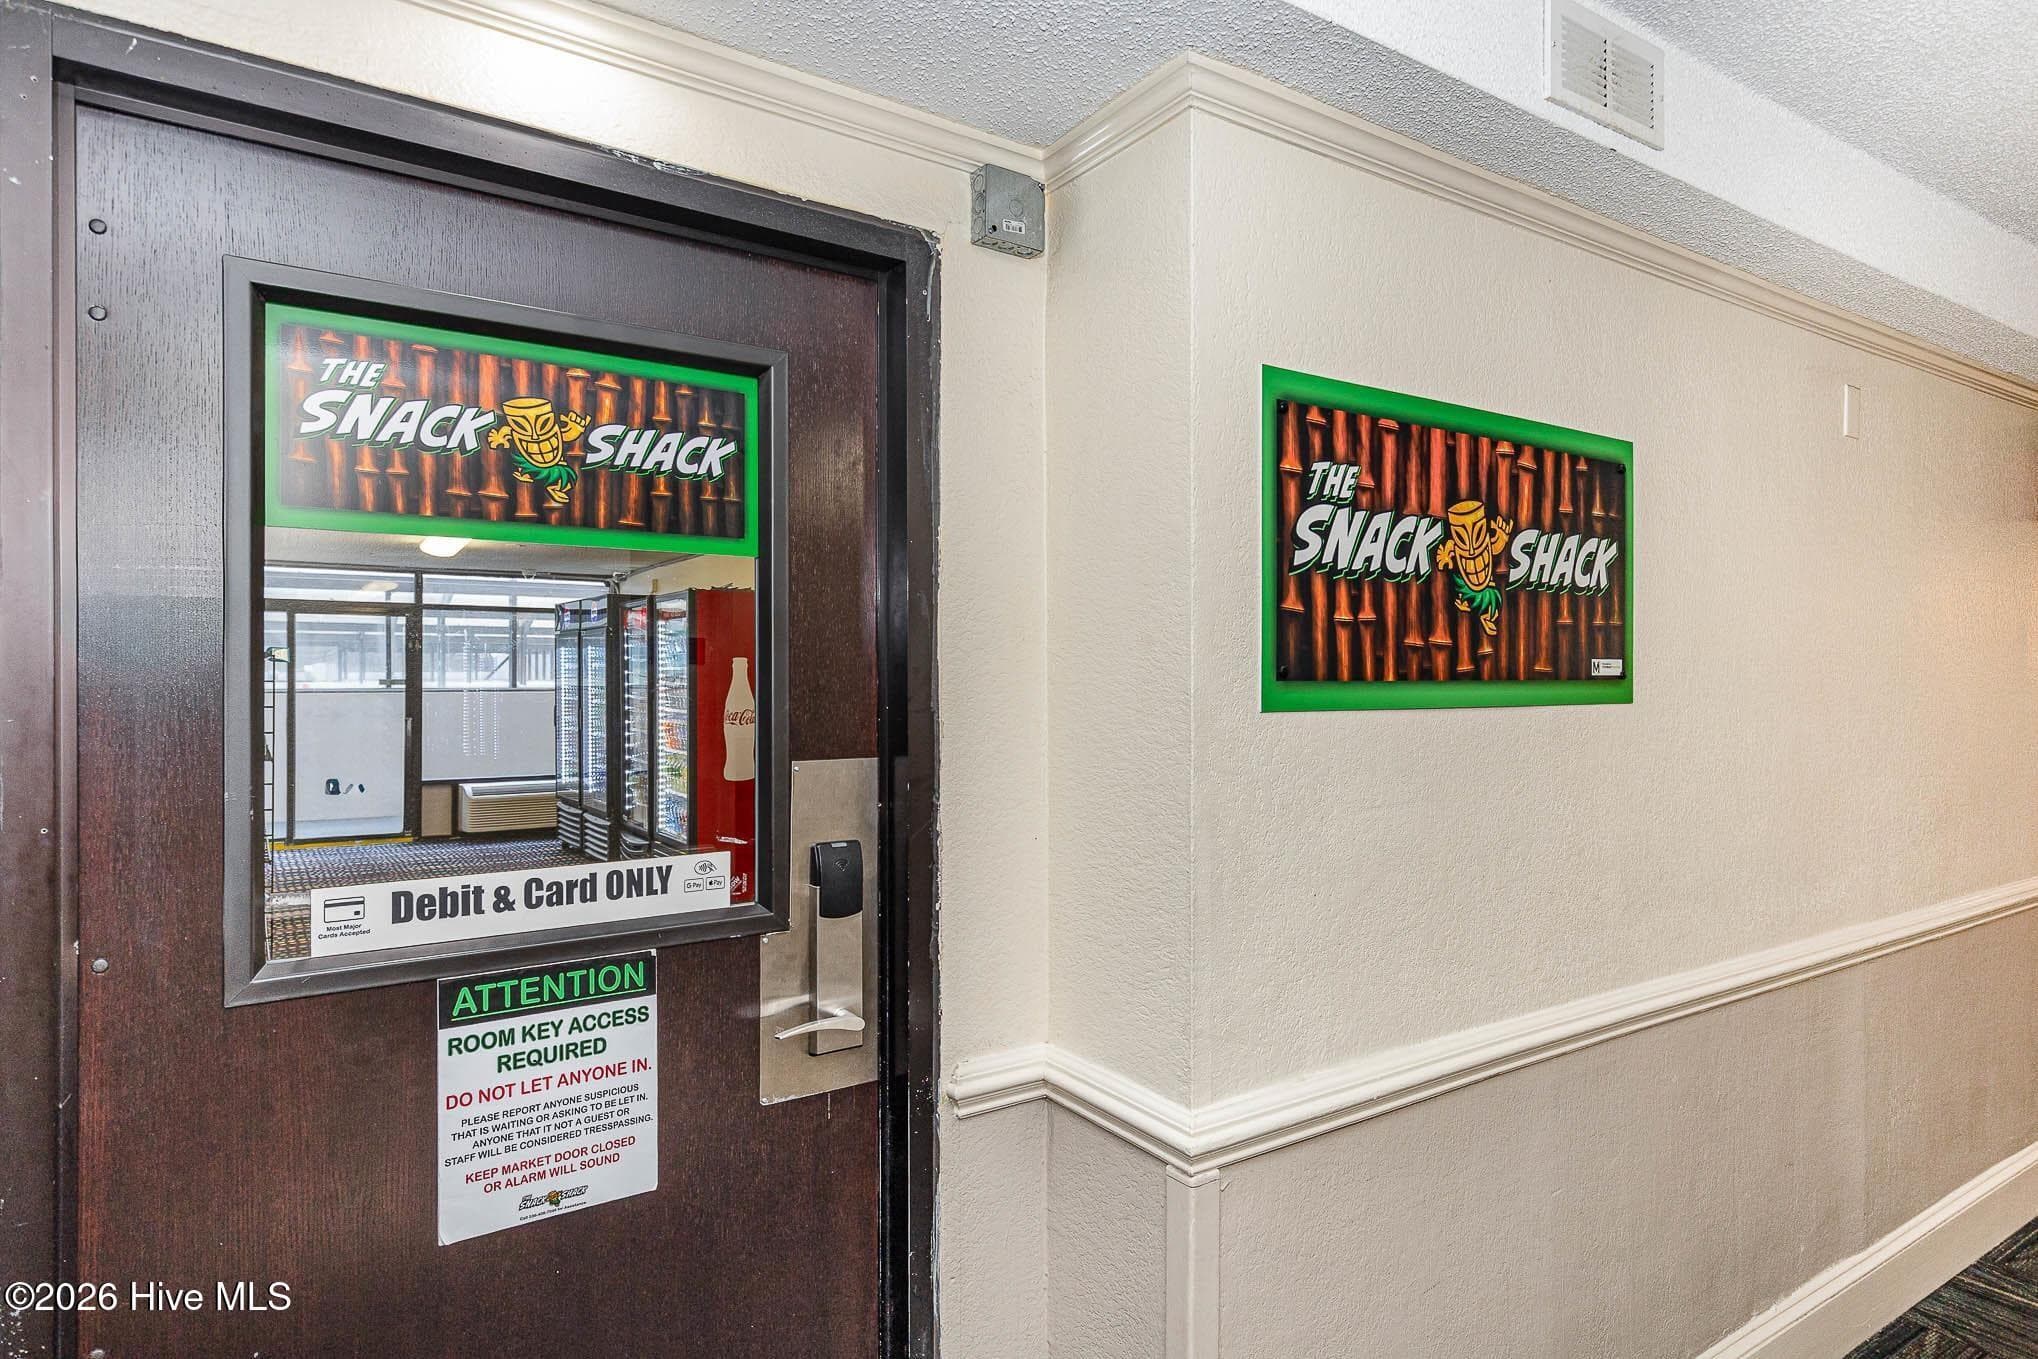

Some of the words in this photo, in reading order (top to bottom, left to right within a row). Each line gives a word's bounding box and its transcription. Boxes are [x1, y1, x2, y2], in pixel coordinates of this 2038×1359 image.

[319, 358, 388, 389] THE
[300, 389, 498, 456] SNACK
[582, 424, 738, 483] SHACK
[1307, 461, 1361, 503] THE
[1289, 504, 1446, 584] SNACK
[1506, 529, 1619, 596] SHACK
[391, 886, 485, 925] Debit
[493, 884, 517, 912] &
[523, 872, 597, 910] Card
[605, 865, 673, 899] ONLY
[340, 929, 371, 937] Accepted
[452, 961, 645, 1017] ATTENTION
[447, 1027, 515, 1056] ROOM
[521, 1019, 564, 1043] KEY
[568, 1006, 650, 1035] ACCESS
[497, 1038, 607, 1073] REQUIRED
[446, 1092, 473, 1110] DO
[479, 1083, 516, 1103] NOT
[521, 1076, 553, 1095] LET
[557, 1061, 627, 1088] ANYONE
[632, 1058, 652, 1074] IN.
[461, 1112, 500, 1127] PLEASE
[502, 1104, 541, 1118] REPORT
[543, 1095, 582, 1110] ANYONE
[584, 1083, 639, 1101] SUSPICIOUS
[444, 1153, 476, 1167] STAFF
[478, 1148, 502, 1160] WILL
[504, 1143, 518, 1154] BE
[519, 1130, 582, 1150] CONSIDERED
[584, 1113, 653, 1136] TRESSPASSING.
[451, 1129, 478, 1141] THAT
[479, 1126, 489, 1135] IS
[491, 1117, 534, 1133] WAITING
[536, 1113, 550, 1123] OR
[552, 1105, 588, 1119] ASKING
[590, 1102, 602, 1111] TO
[604, 1100, 617, 1108] BE
[618, 1095, 635, 1106] LET
[636, 1093, 648, 1102] IN.
[472, 1133, 514, 1149] ANYONE
[516, 1126, 542, 1139] THAT
[543, 1125, 552, 1133] IT
[554, 1120, 573, 1132] NOT
[575, 1117, 582, 1126] A
[584, 1110, 615, 1125] GUEST
[616, 1107, 630, 1117] OR
[465, 1168, 499, 1185] KEEP
[501, 1155, 552, 1175] MARKET
[555, 1146, 588, 1163] DOOR
[591, 1135, 635, 1153] CLOSED
[484, 1181, 501, 1194] OR
[504, 1171, 547, 1189] ALARM
[549, 1164, 577, 1178] WILL
[579, 1152, 620, 1169] SOUND
[560, 1185, 588, 1200] SHACK
